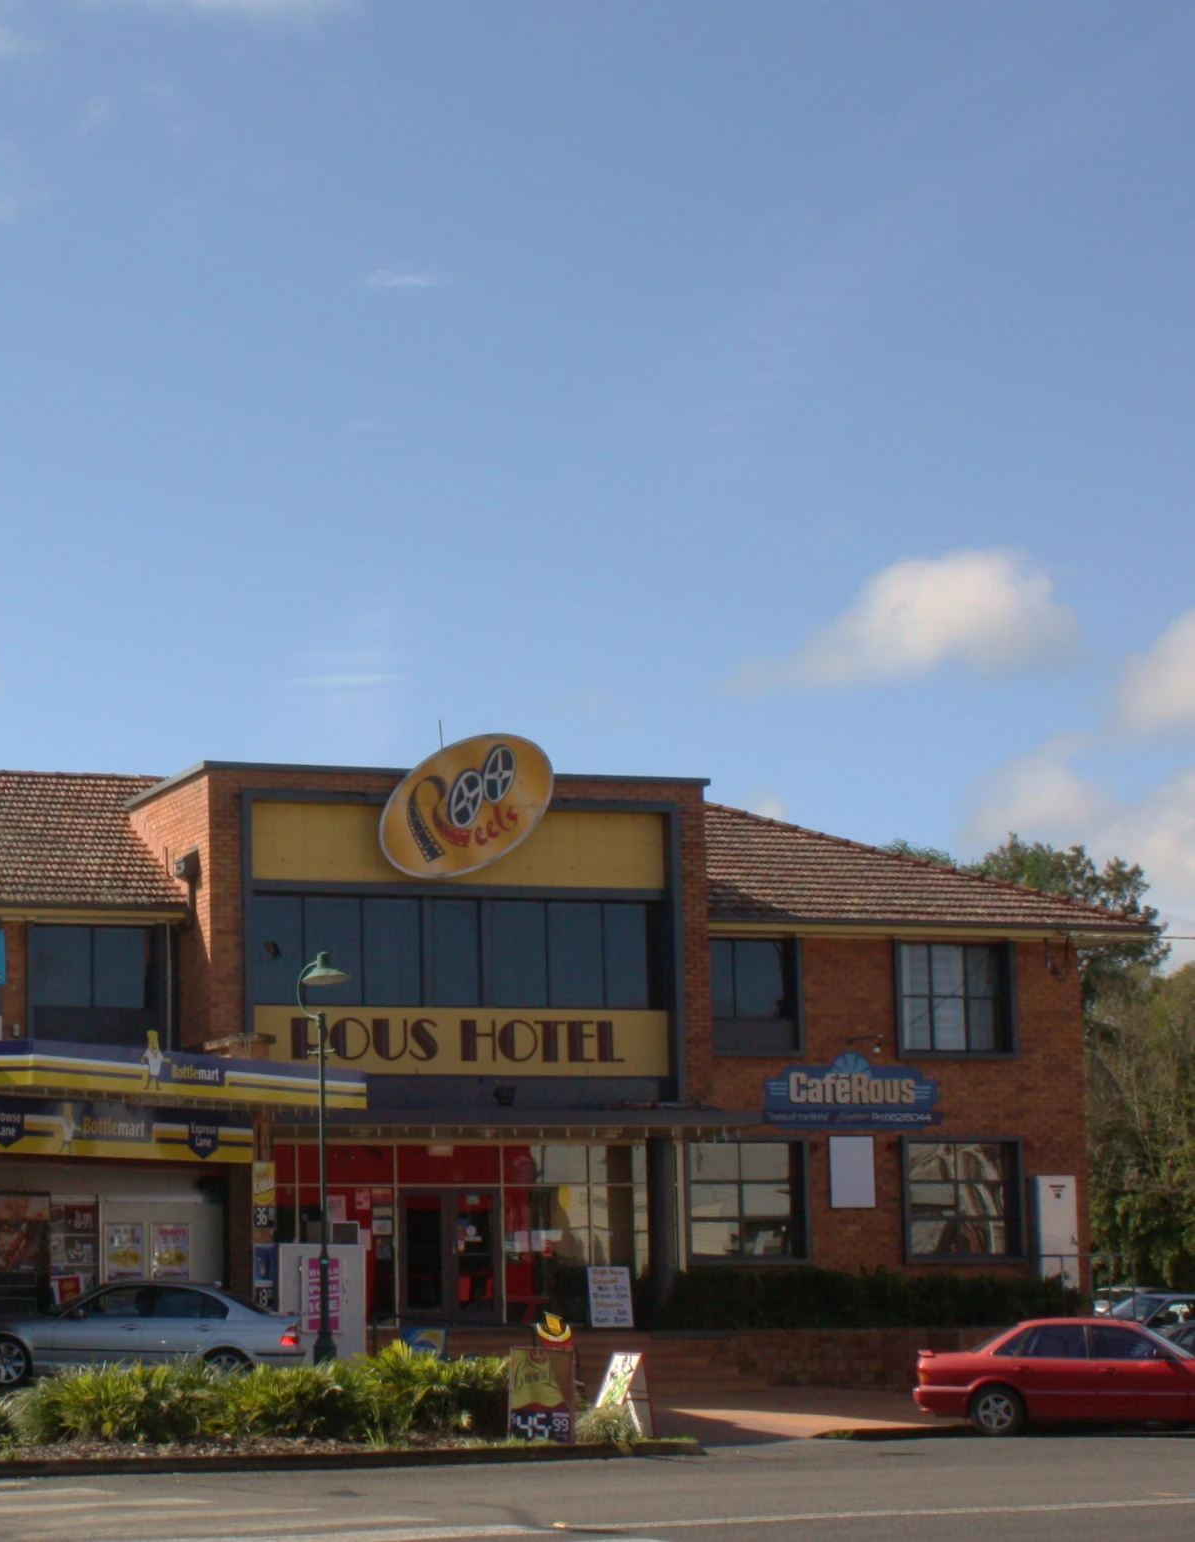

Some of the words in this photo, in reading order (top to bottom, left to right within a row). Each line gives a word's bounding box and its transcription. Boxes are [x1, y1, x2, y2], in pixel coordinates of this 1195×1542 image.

[290, 1017, 438, 1061] ROUS
[460, 1018, 626, 1063] HOTEL
[171, 1064, 220, 1081] Bottlemart
[83, 1115, 146, 1138] Bottlemart
[190, 1122, 217, 1137] Express
[195, 1134, 213, 1148] Lane
[254, 1178, 275, 1194] GOLD
[308, 1283, 339, 1295] PE
[308, 1298, 339, 1315] ICE
